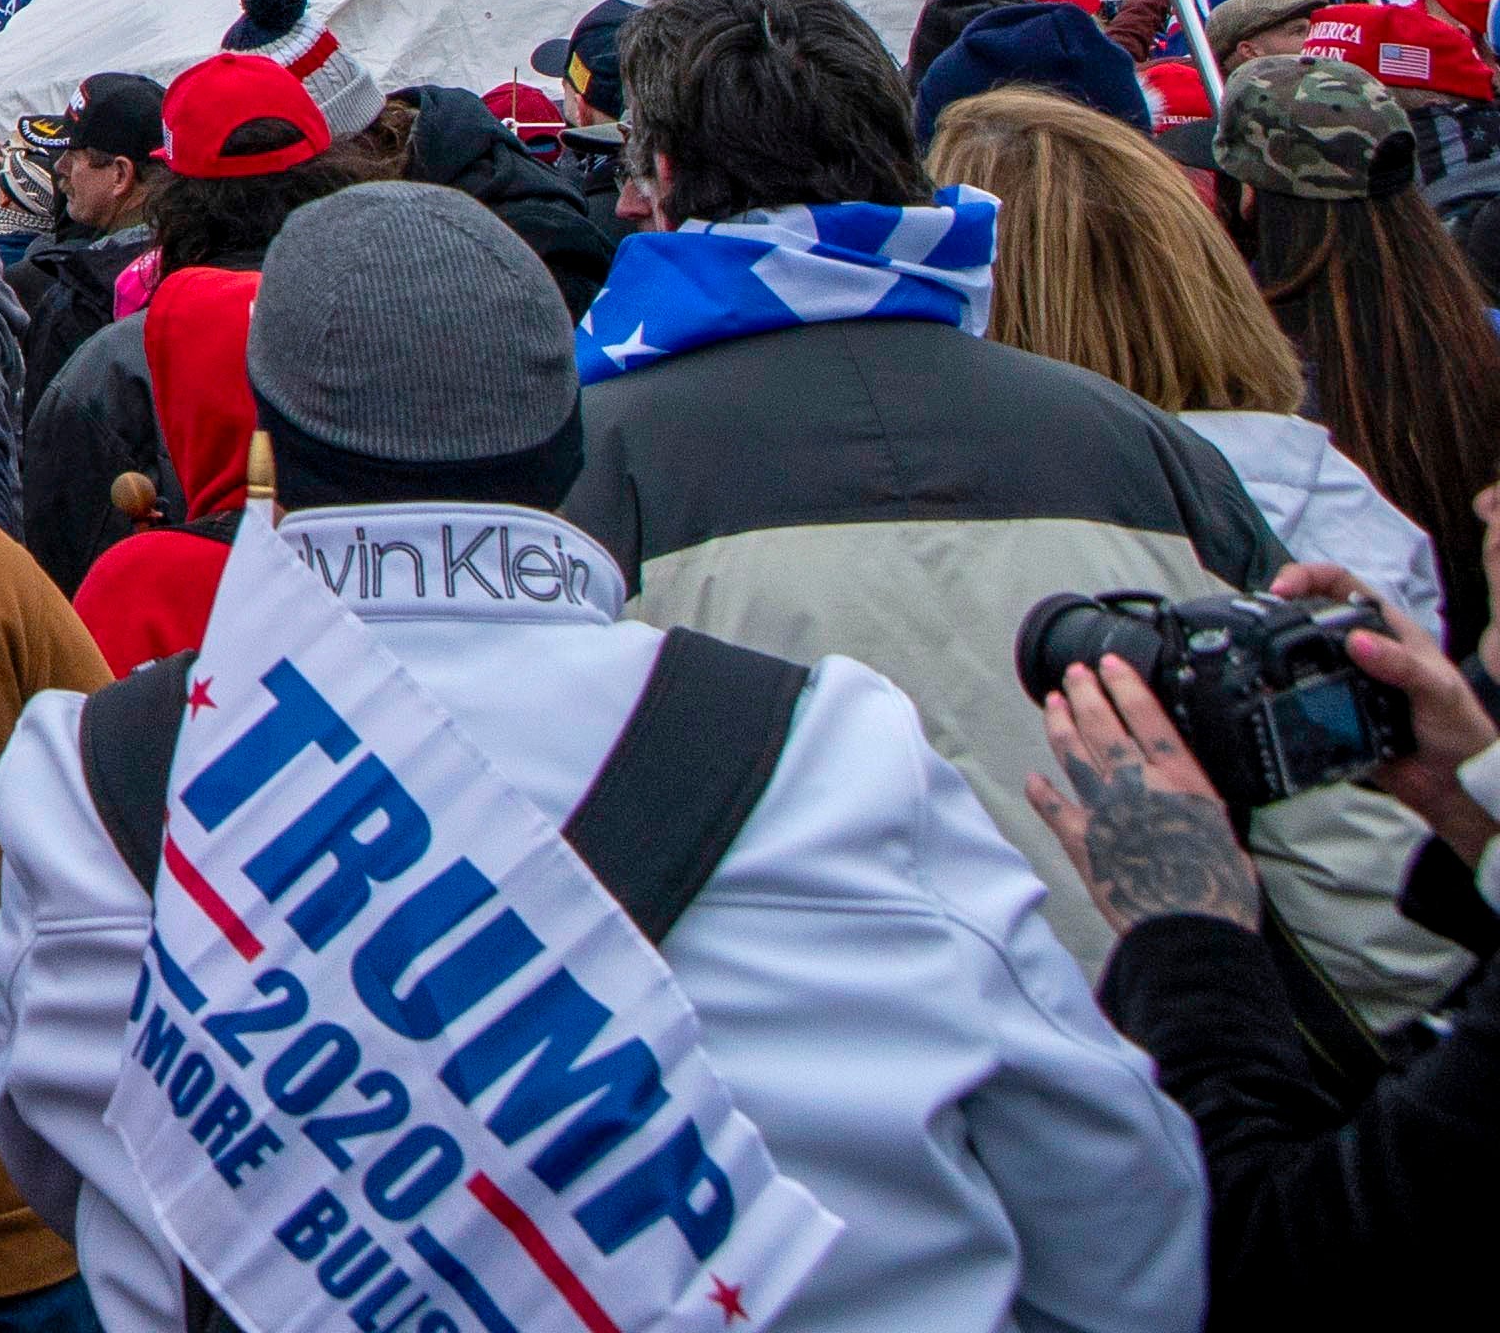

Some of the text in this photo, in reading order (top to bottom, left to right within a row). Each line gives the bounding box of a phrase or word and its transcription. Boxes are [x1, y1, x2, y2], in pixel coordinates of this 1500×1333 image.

[441, 524, 591, 606] Klein
[180, 656, 738, 1259] TRUMP
[132, 1003, 285, 1191] MORE
[201, 967, 465, 1222] 2020
